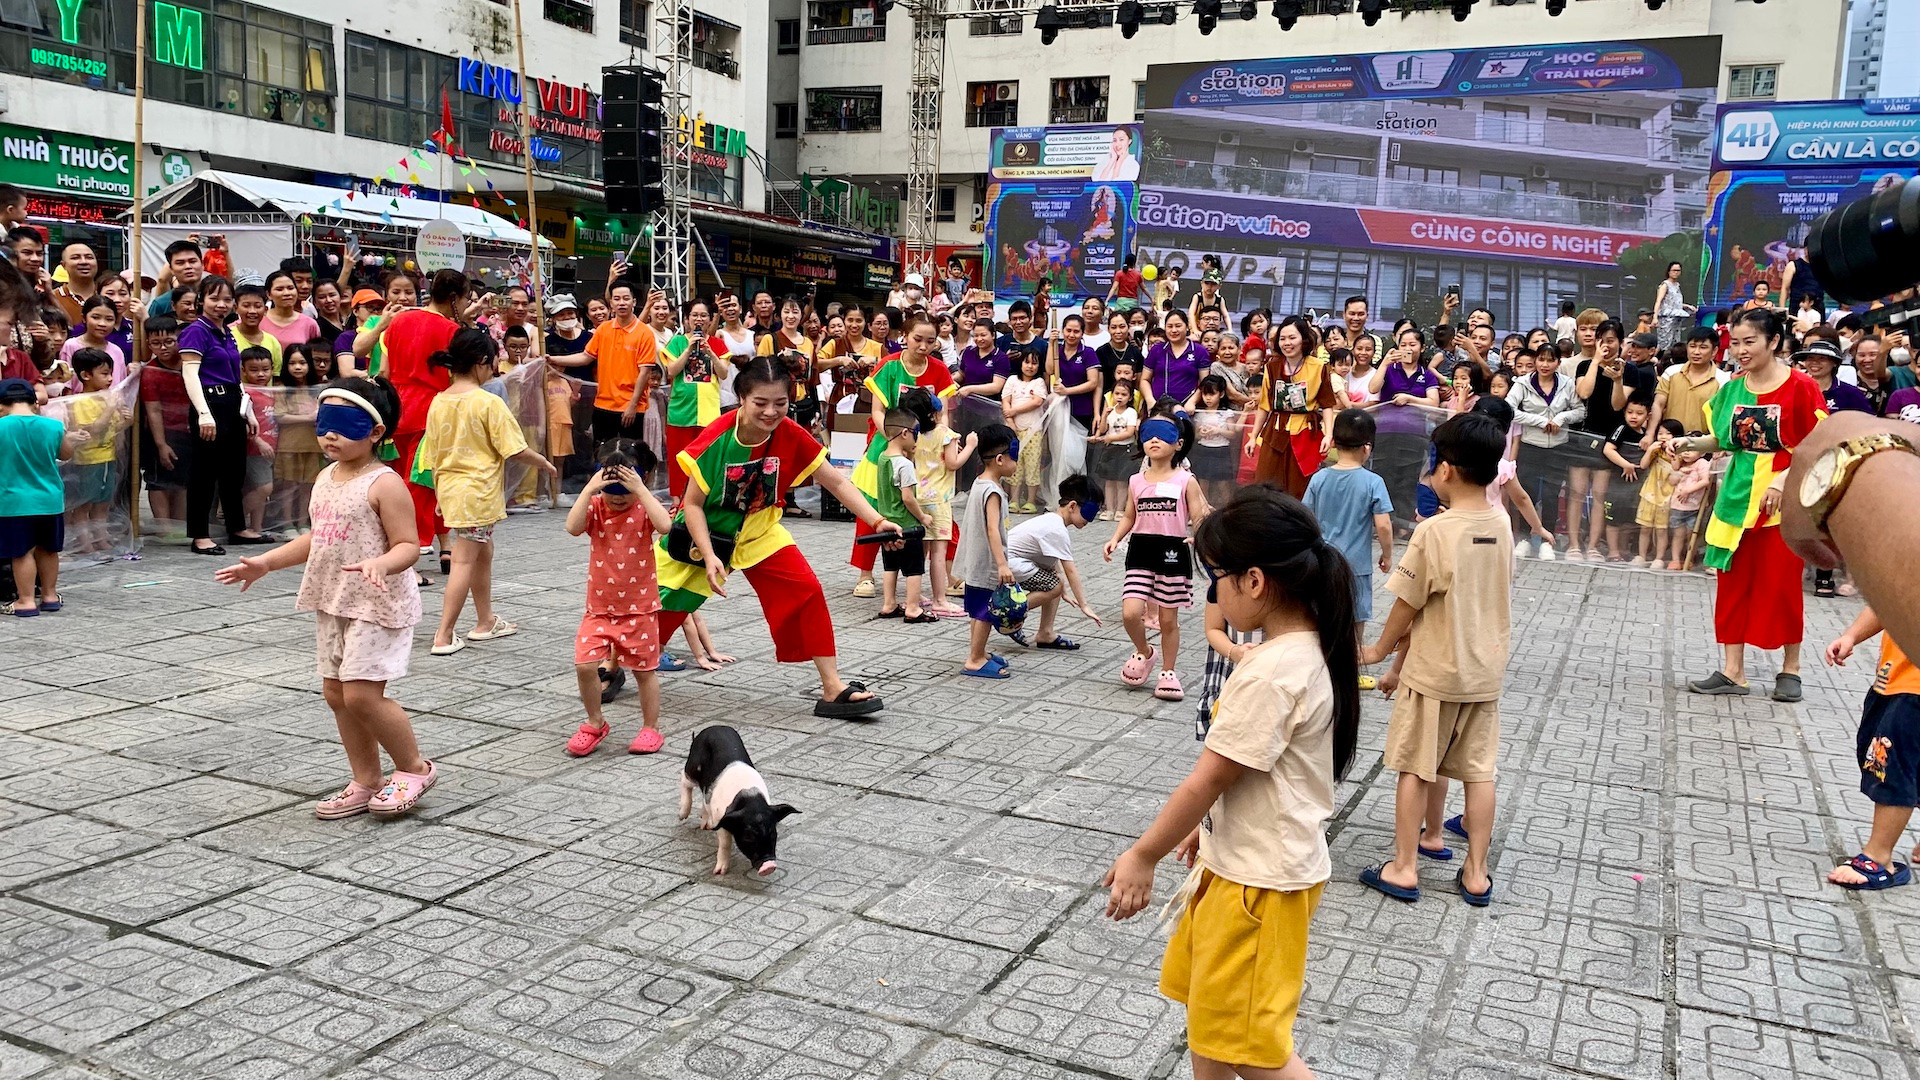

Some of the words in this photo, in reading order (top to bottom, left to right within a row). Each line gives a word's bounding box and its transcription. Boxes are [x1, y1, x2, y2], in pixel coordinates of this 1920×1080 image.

[31, 48, 107, 77] 0987854262
[1583, 66, 1644, 78] NGHIỆM
[458, 57, 523, 104] KHU
[537, 78, 588, 119] VUI
[1201, 69, 1285, 91] station
[1376, 111, 1438, 130] station
[1787, 120, 1811, 131] HIỆP
[1812, 119, 1831, 130] HỘI
[1833, 120, 1859, 129] KINH
[1861, 119, 1900, 128] DOANH
[1902, 119, 1918, 127] UY
[714, 123, 747, 158] EM
[1726, 122, 1771, 147] 4H
[4, 135, 50, 162] NHÀ
[59, 146, 129, 174] THUỐC
[1787, 136, 1842, 159] CẦN
[1844, 136, 1877, 158] LÀ
[1882, 135, 1920, 158] CÓ
[57, 173, 80, 187] Hai
[850, 185, 898, 232] Mart
[1410, 218, 1477, 244] CÙNG
[1481, 225, 1548, 249] CÔNG
[1552, 235, 1613, 262] NGHỆ
[1137, 501, 1163, 511] adidas
